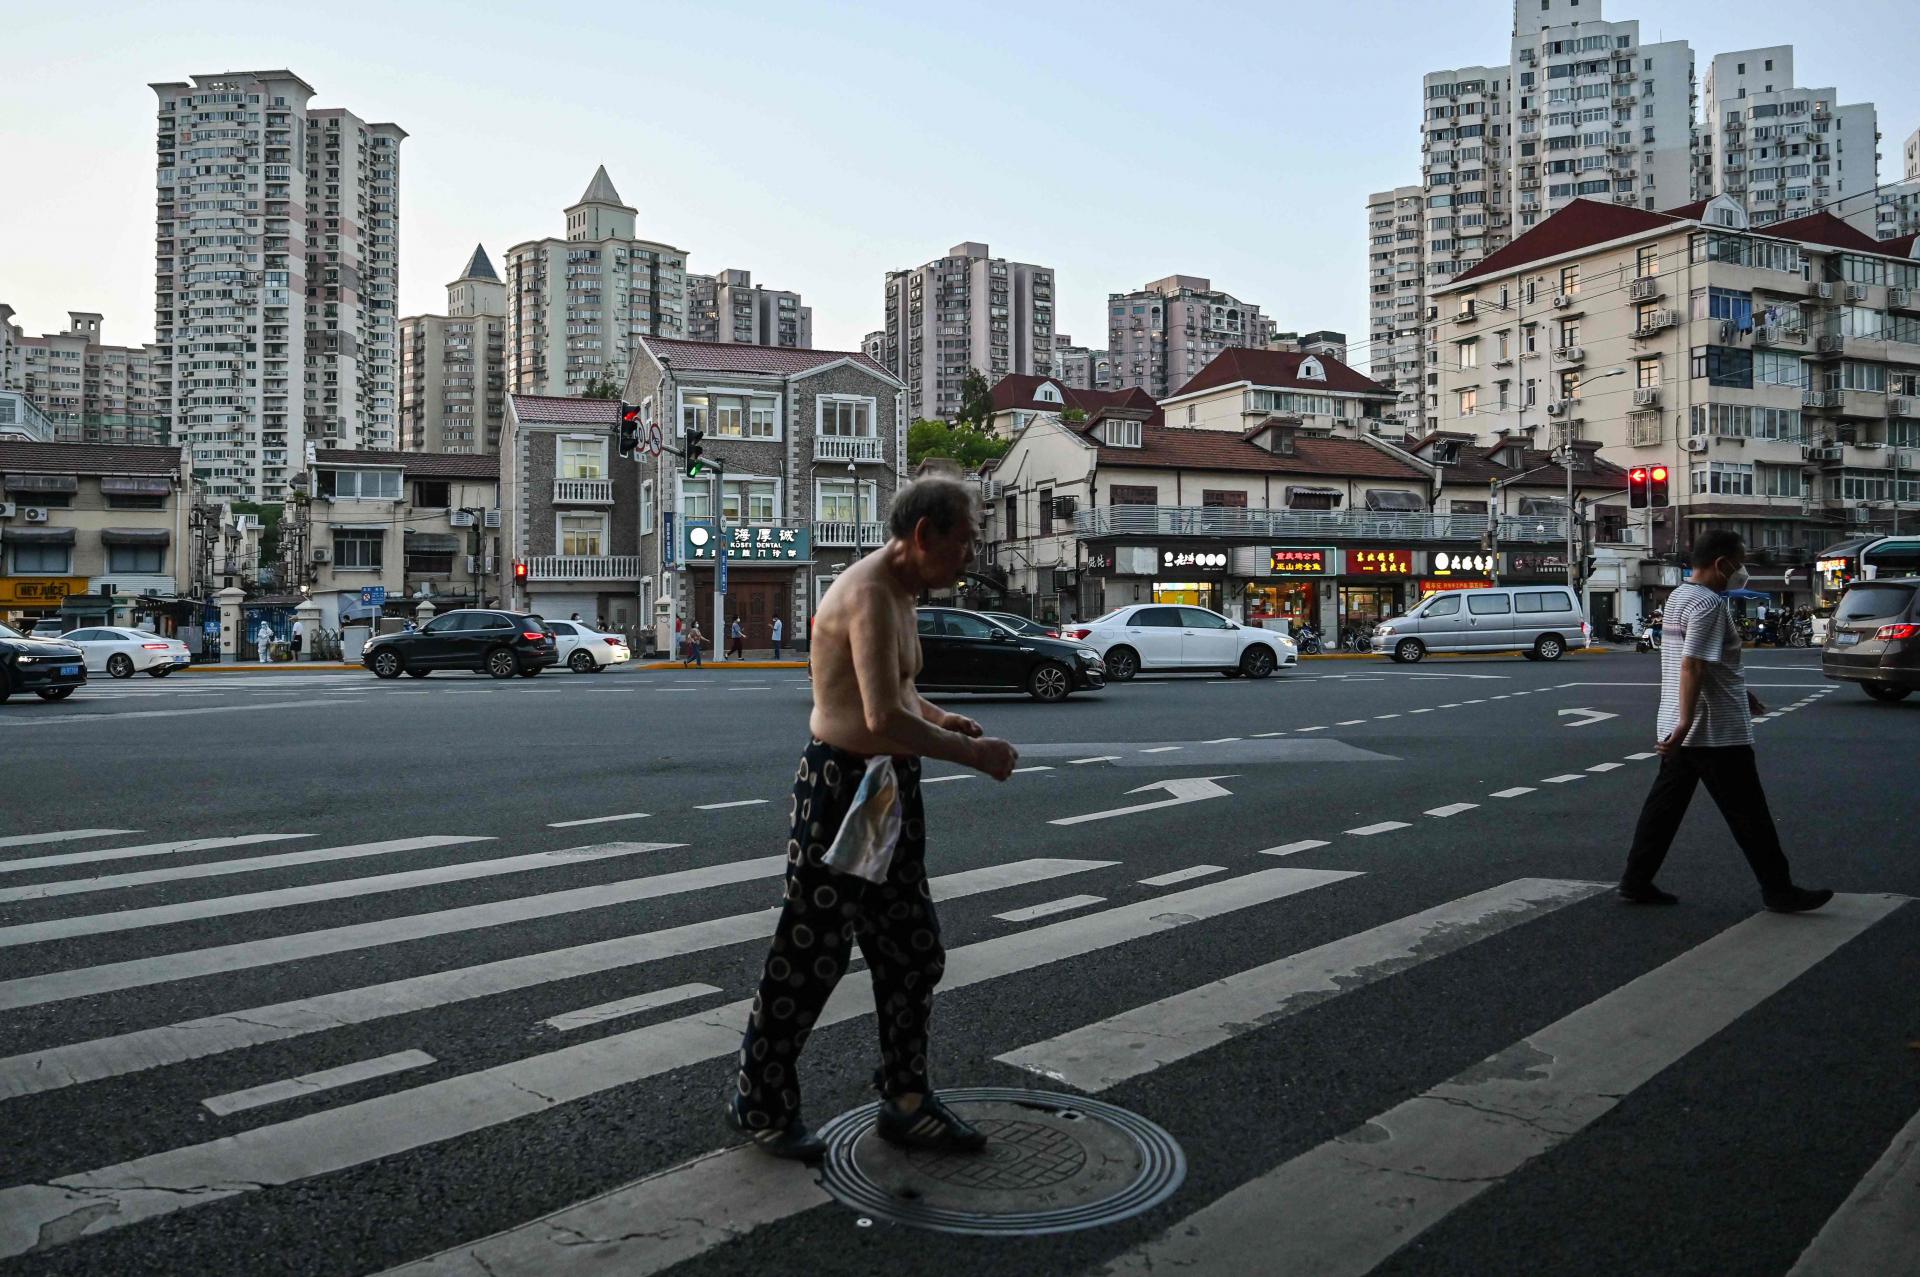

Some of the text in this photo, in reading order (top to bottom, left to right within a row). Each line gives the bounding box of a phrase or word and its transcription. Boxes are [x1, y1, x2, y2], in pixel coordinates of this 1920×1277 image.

[712, 528, 795, 542] 海厚诚
[1275, 562, 1322, 571] 巫山烤全鱼
